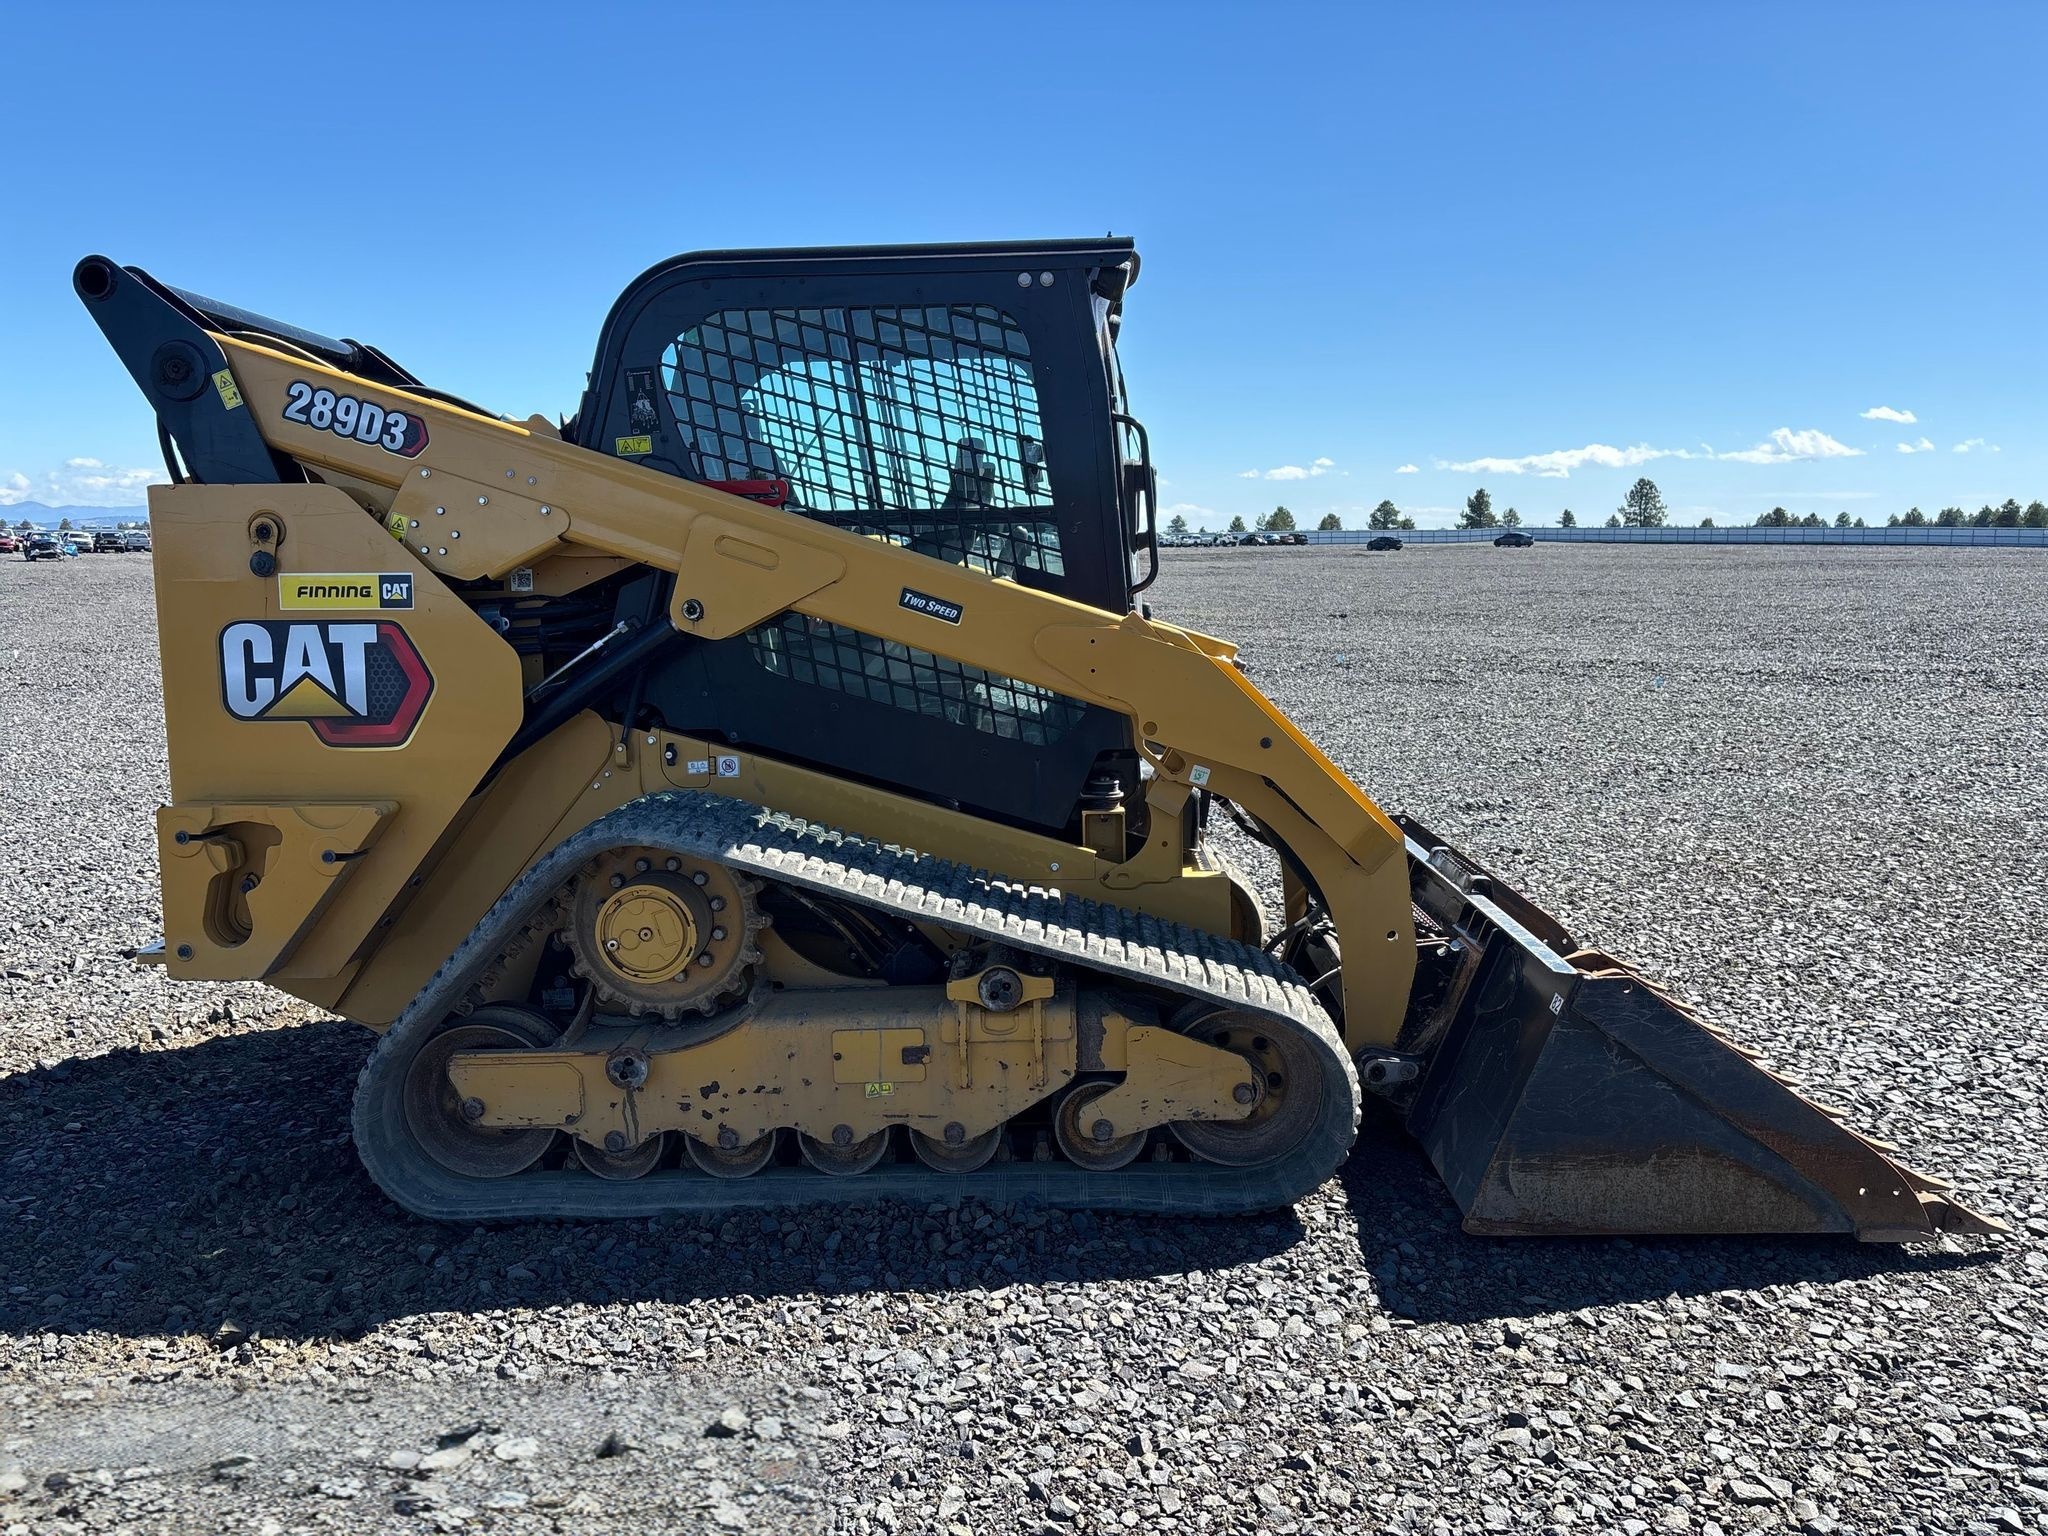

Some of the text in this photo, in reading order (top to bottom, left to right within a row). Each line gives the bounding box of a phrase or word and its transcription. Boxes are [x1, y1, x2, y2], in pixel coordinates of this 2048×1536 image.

[284, 382, 408, 450] 289D3
[297, 585, 372, 598] FINNING
[382, 583, 409, 600] CAT
[222, 622, 378, 717] CAT
